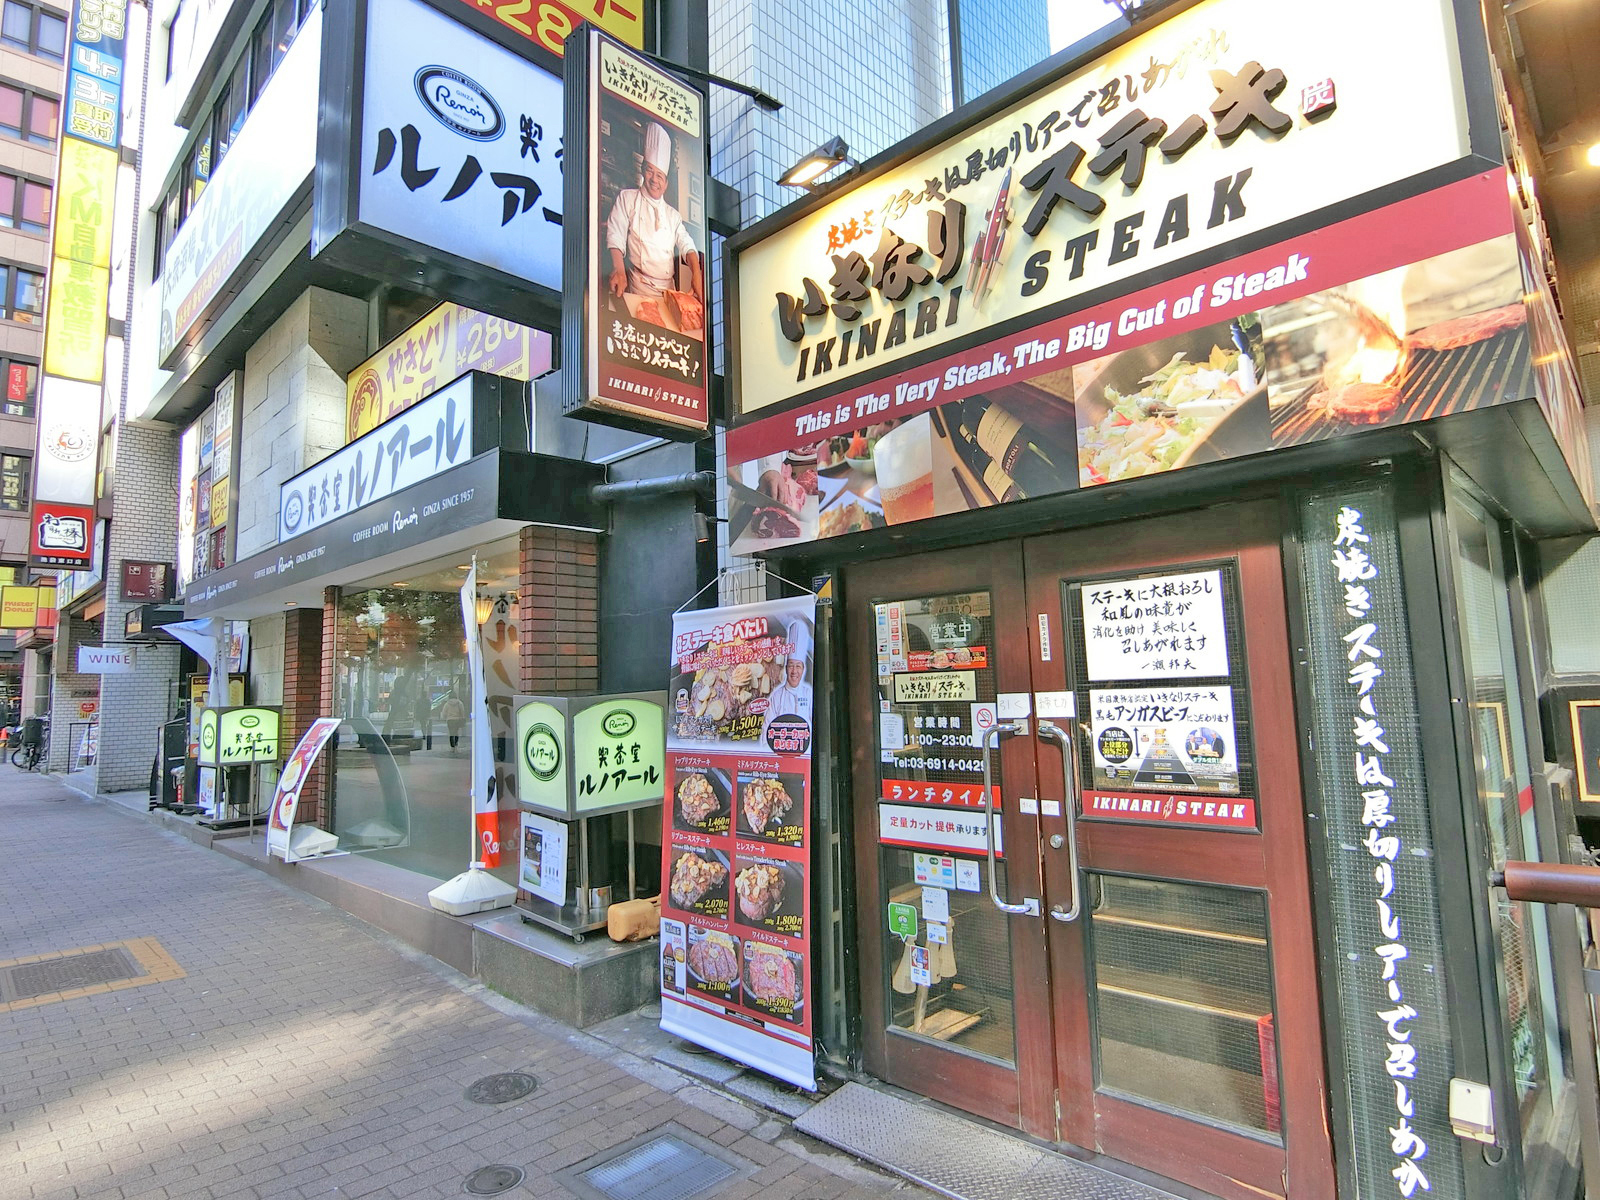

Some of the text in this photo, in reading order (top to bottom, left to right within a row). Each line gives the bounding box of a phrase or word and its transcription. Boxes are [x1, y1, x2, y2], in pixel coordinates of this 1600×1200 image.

[77, 46, 119, 79] 4F
[75, 74, 116, 106] 3F
[435, 84, 486, 125] Renoir
[604, 58, 693, 120] いきなり ステーキ
[608, 76, 689, 127] IKINARI STEAK
[74, 99, 113, 126] 買取
[72, 115, 113, 143] 受付
[774, 60, 1293, 343] いきなり ステーキ
[796, 167, 1254, 383] IKINARI STEAK
[387, 311, 450, 392] やきとり
[794, 252, 1311, 438] This is The Very Steak, The Big Cut of Steak
[608, 377, 699, 409] IKINARI STEAK
[347, 397, 467, 513] ルノアール
[352, 488, 475, 543] COFFEE ROOM Renoir GINZA SINCE 1957
[929, 616, 972, 640] 営業中
[89, 654, 131, 665] WINE
[900, 680, 966, 693] いきなり ステーキ
[913, 716, 960, 729] 営業時間
[223, 744, 274, 758] ルノアール
[530, 746, 556, 762] ルノアール
[598, 741, 641, 769] 喫茶室
[579, 765, 660, 798] ルノアール
[1092, 796, 1246, 819] IKINARI STEAK
